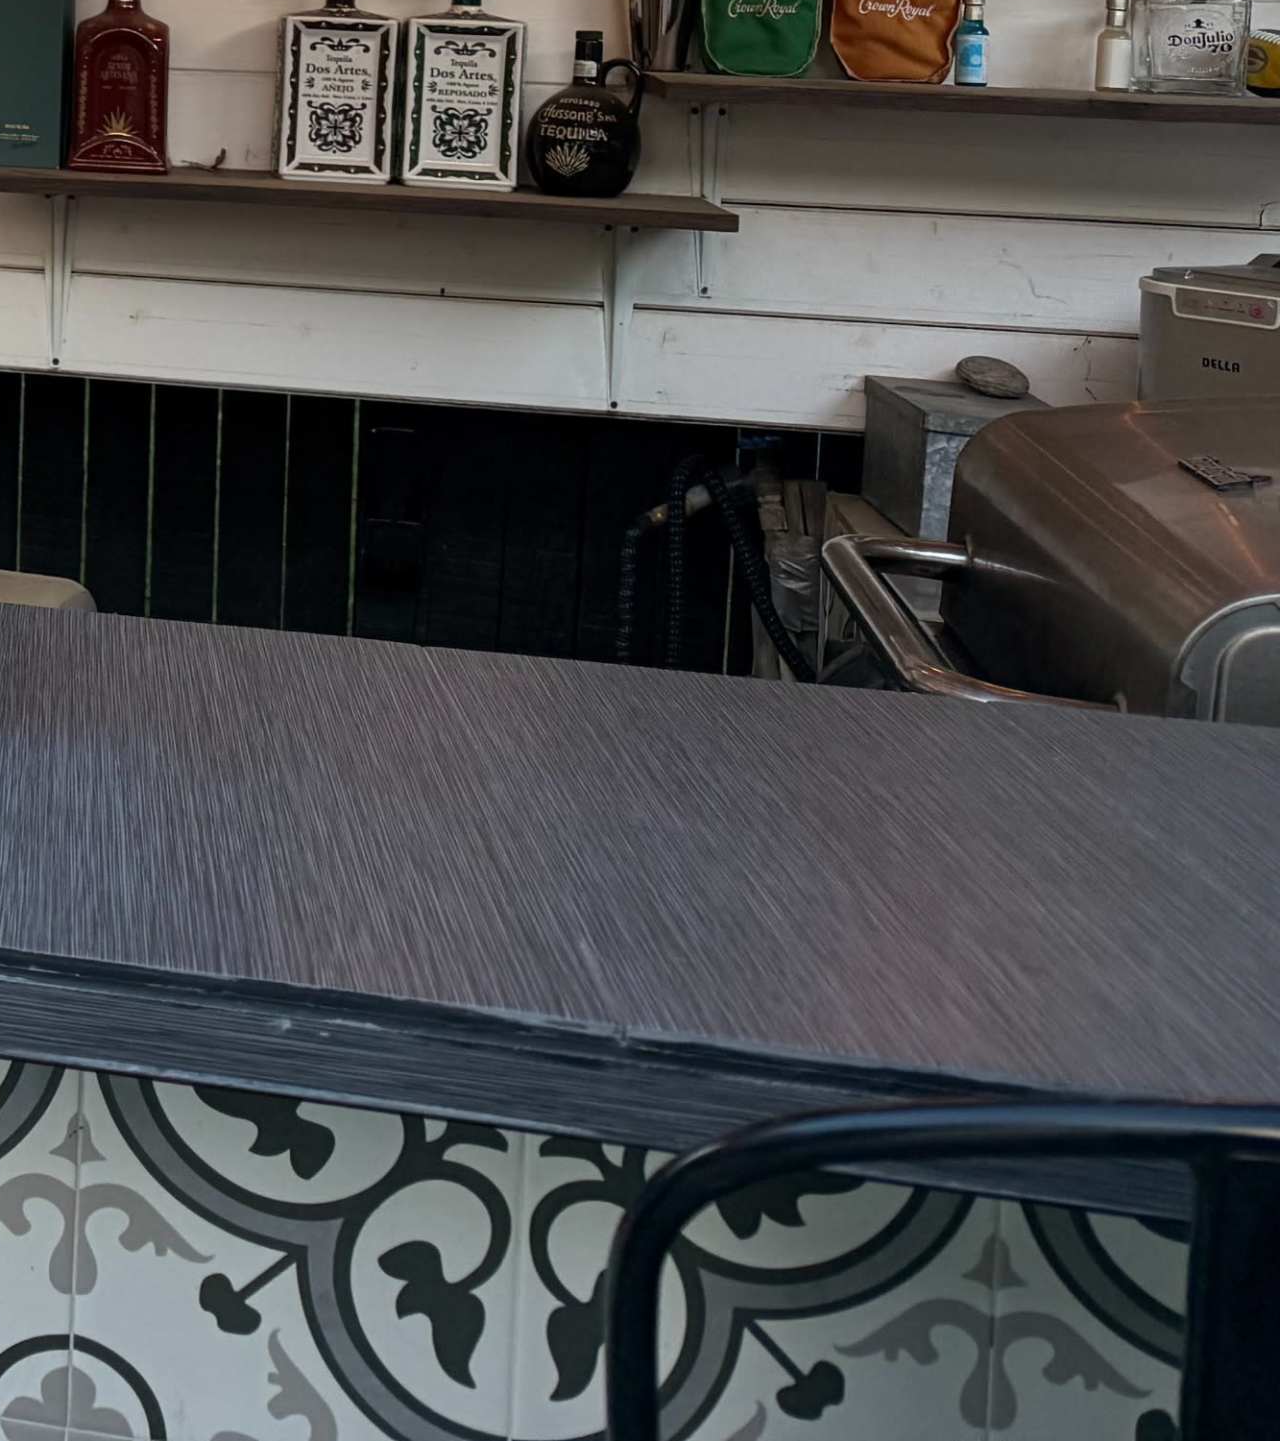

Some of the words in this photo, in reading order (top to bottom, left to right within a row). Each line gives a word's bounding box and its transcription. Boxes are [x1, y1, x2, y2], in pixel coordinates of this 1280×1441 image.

[326, 54, 353, 64] Tequila
[450, 58, 478, 68] Tequila
[305, 63, 330, 74] Dos
[430, 67, 456, 79] Dos
[437, 88, 487, 98] REPOSADO
[1201, 357, 1241, 373] DELLA
